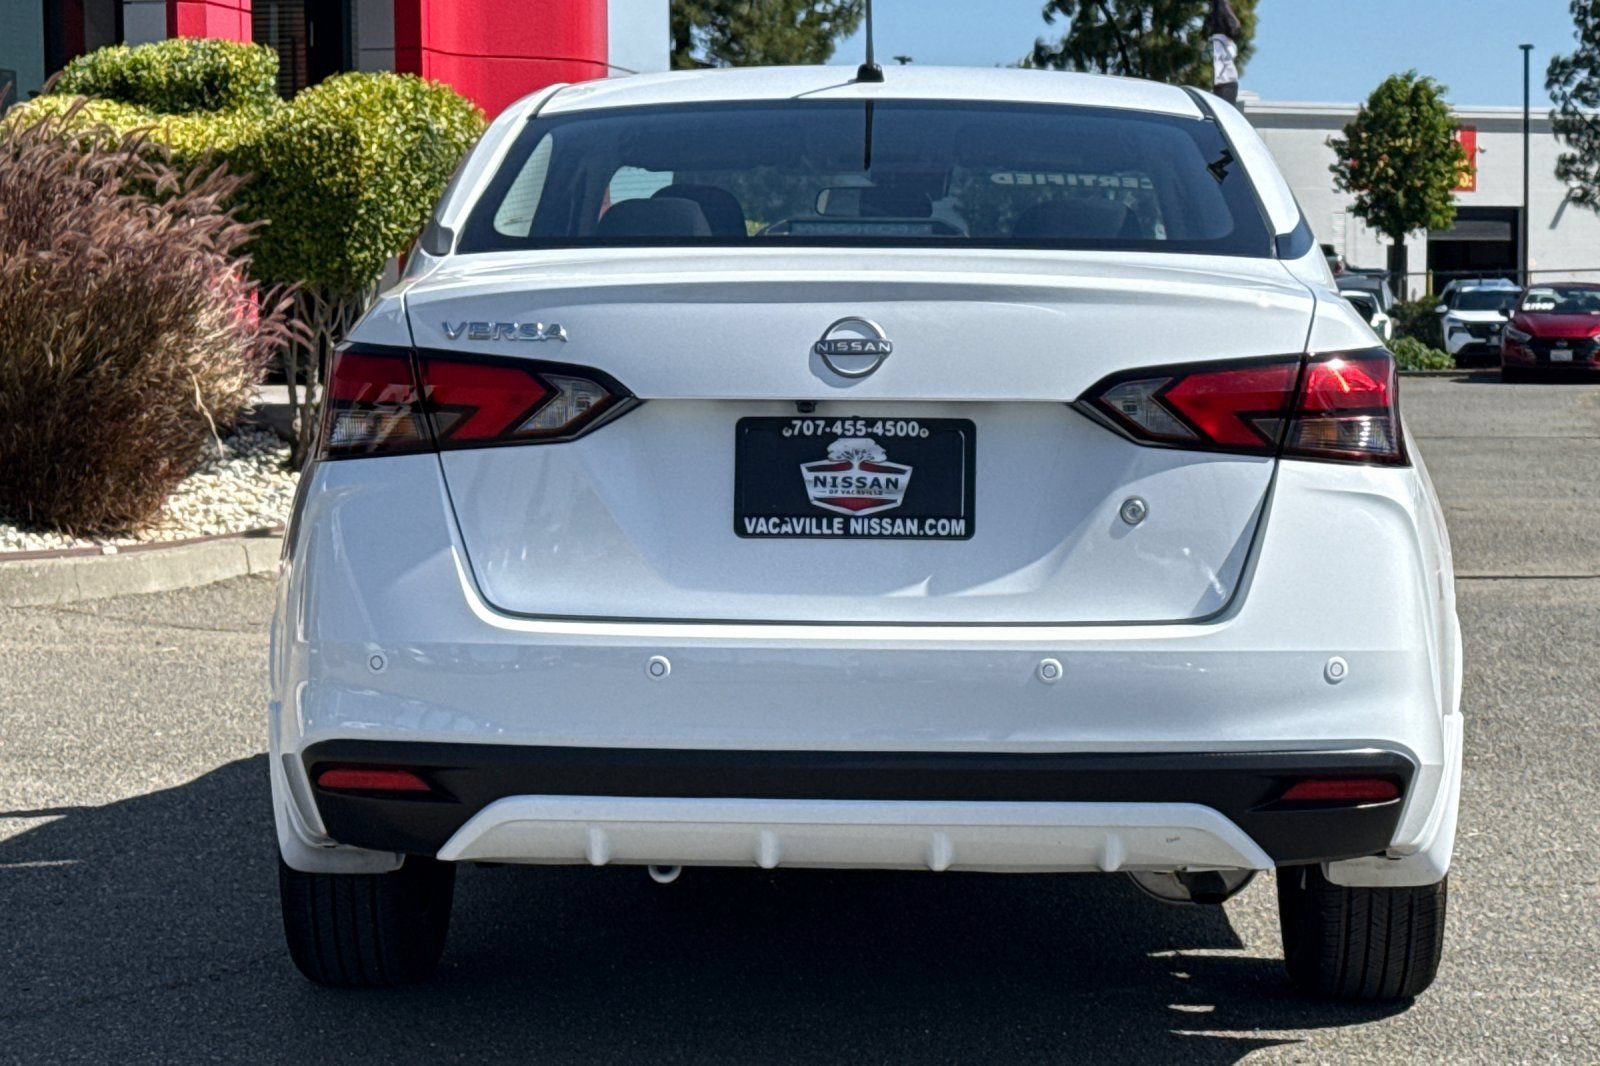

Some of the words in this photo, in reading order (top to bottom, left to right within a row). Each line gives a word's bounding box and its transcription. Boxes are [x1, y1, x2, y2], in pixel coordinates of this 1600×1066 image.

[442, 321, 567, 342] VERSA
[816, 341, 891, 353] NISSAN
[792, 421, 919, 437] 707-455-4500
[813, 476, 899, 490] NISSAN
[744, 517, 844, 535] VACAVILLE
[850, 518, 965, 536] NISSAN.COM
